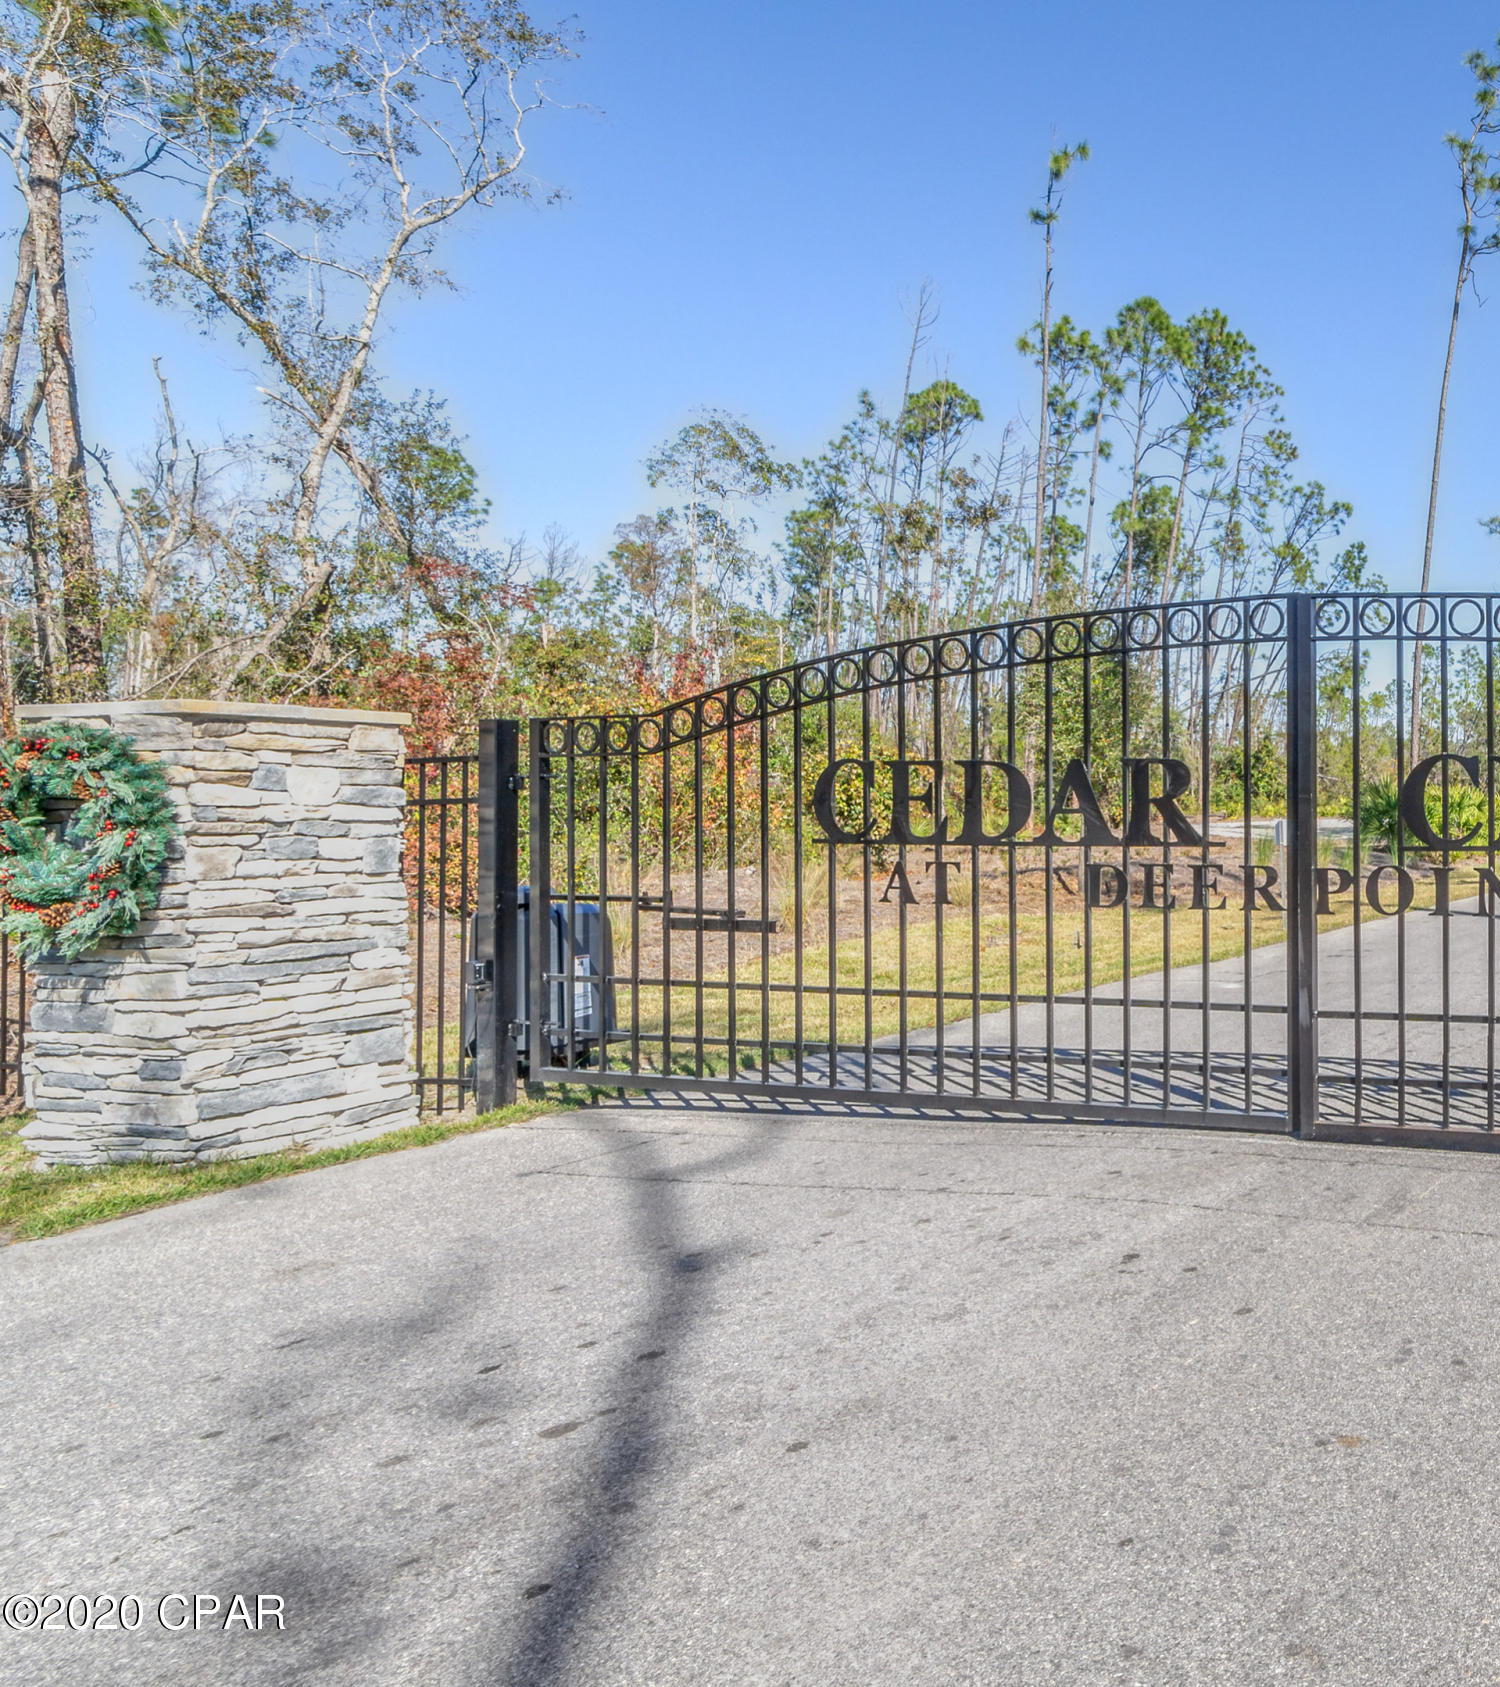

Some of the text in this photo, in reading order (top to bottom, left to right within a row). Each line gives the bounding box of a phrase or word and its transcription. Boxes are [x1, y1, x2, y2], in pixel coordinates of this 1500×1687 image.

[813, 758, 1202, 846] CEDAR
[879, 861, 961, 904] AT
[1087, 863, 1286, 911] DEER
